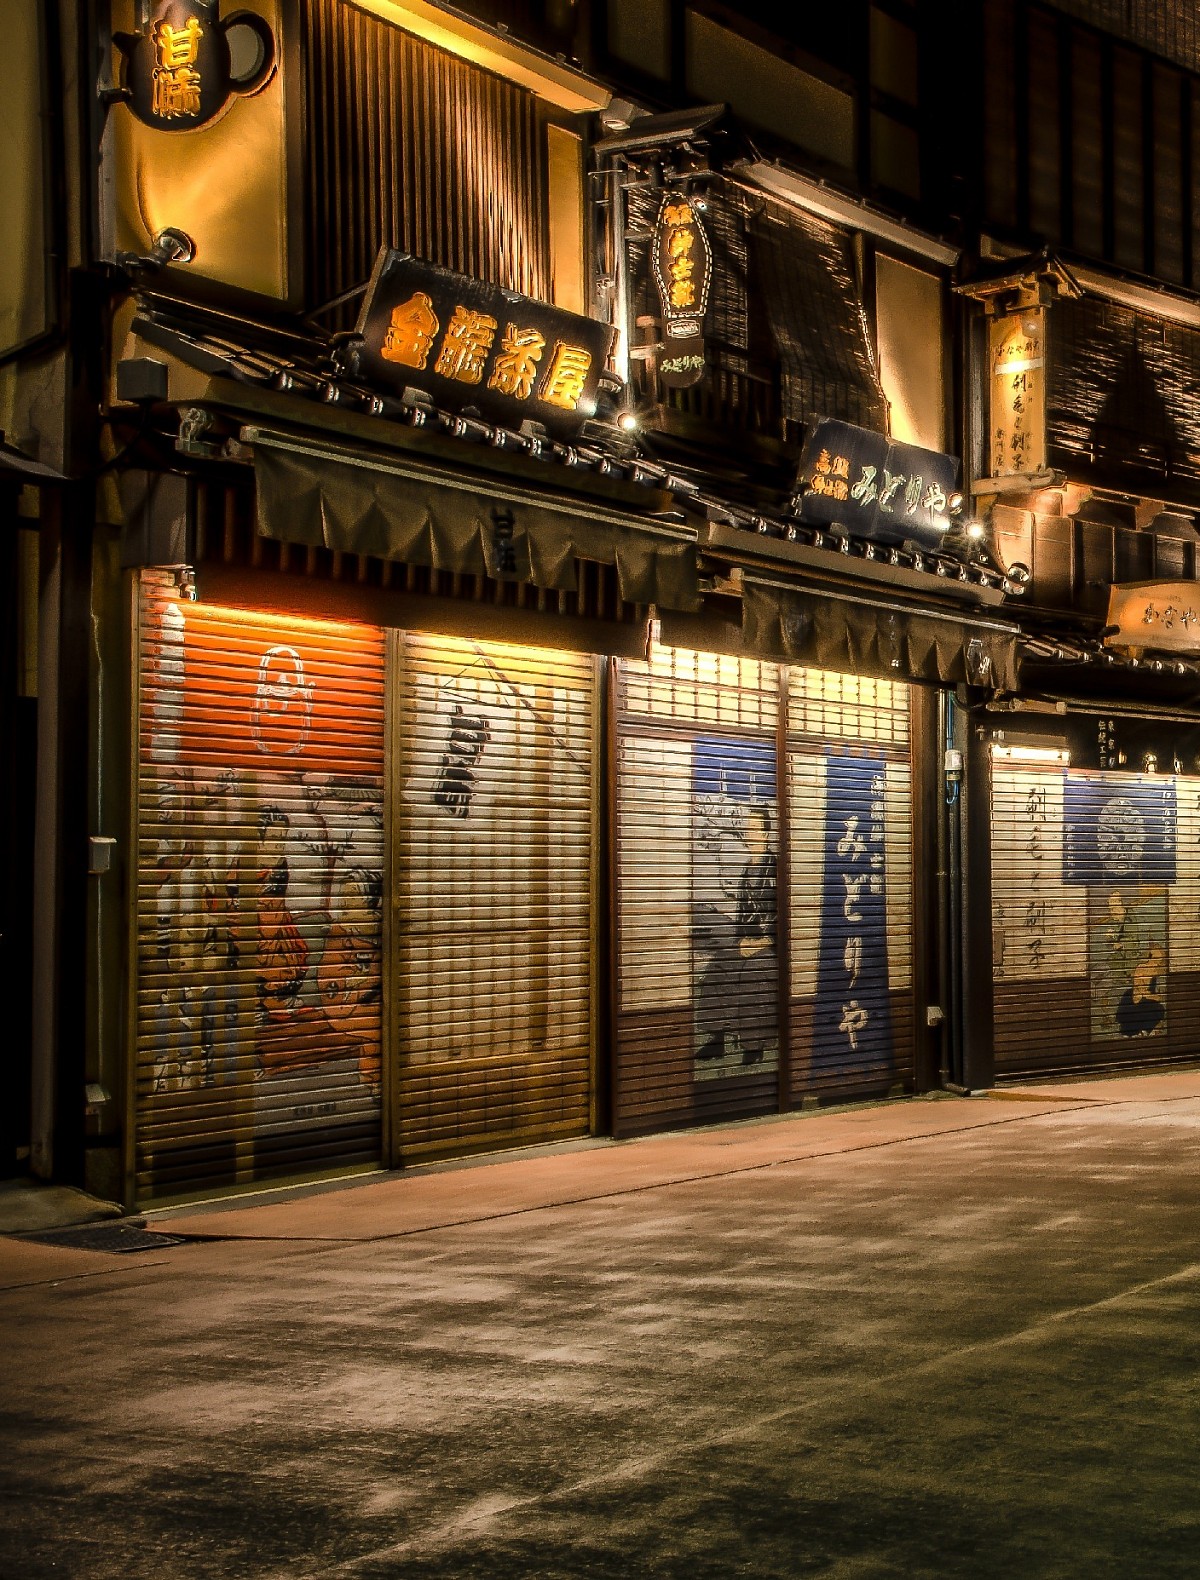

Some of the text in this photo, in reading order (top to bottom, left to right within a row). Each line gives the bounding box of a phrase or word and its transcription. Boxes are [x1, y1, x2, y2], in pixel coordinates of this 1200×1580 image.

[851, 466, 946, 523] みどりや
[837, 815, 870, 1050] みどりや
